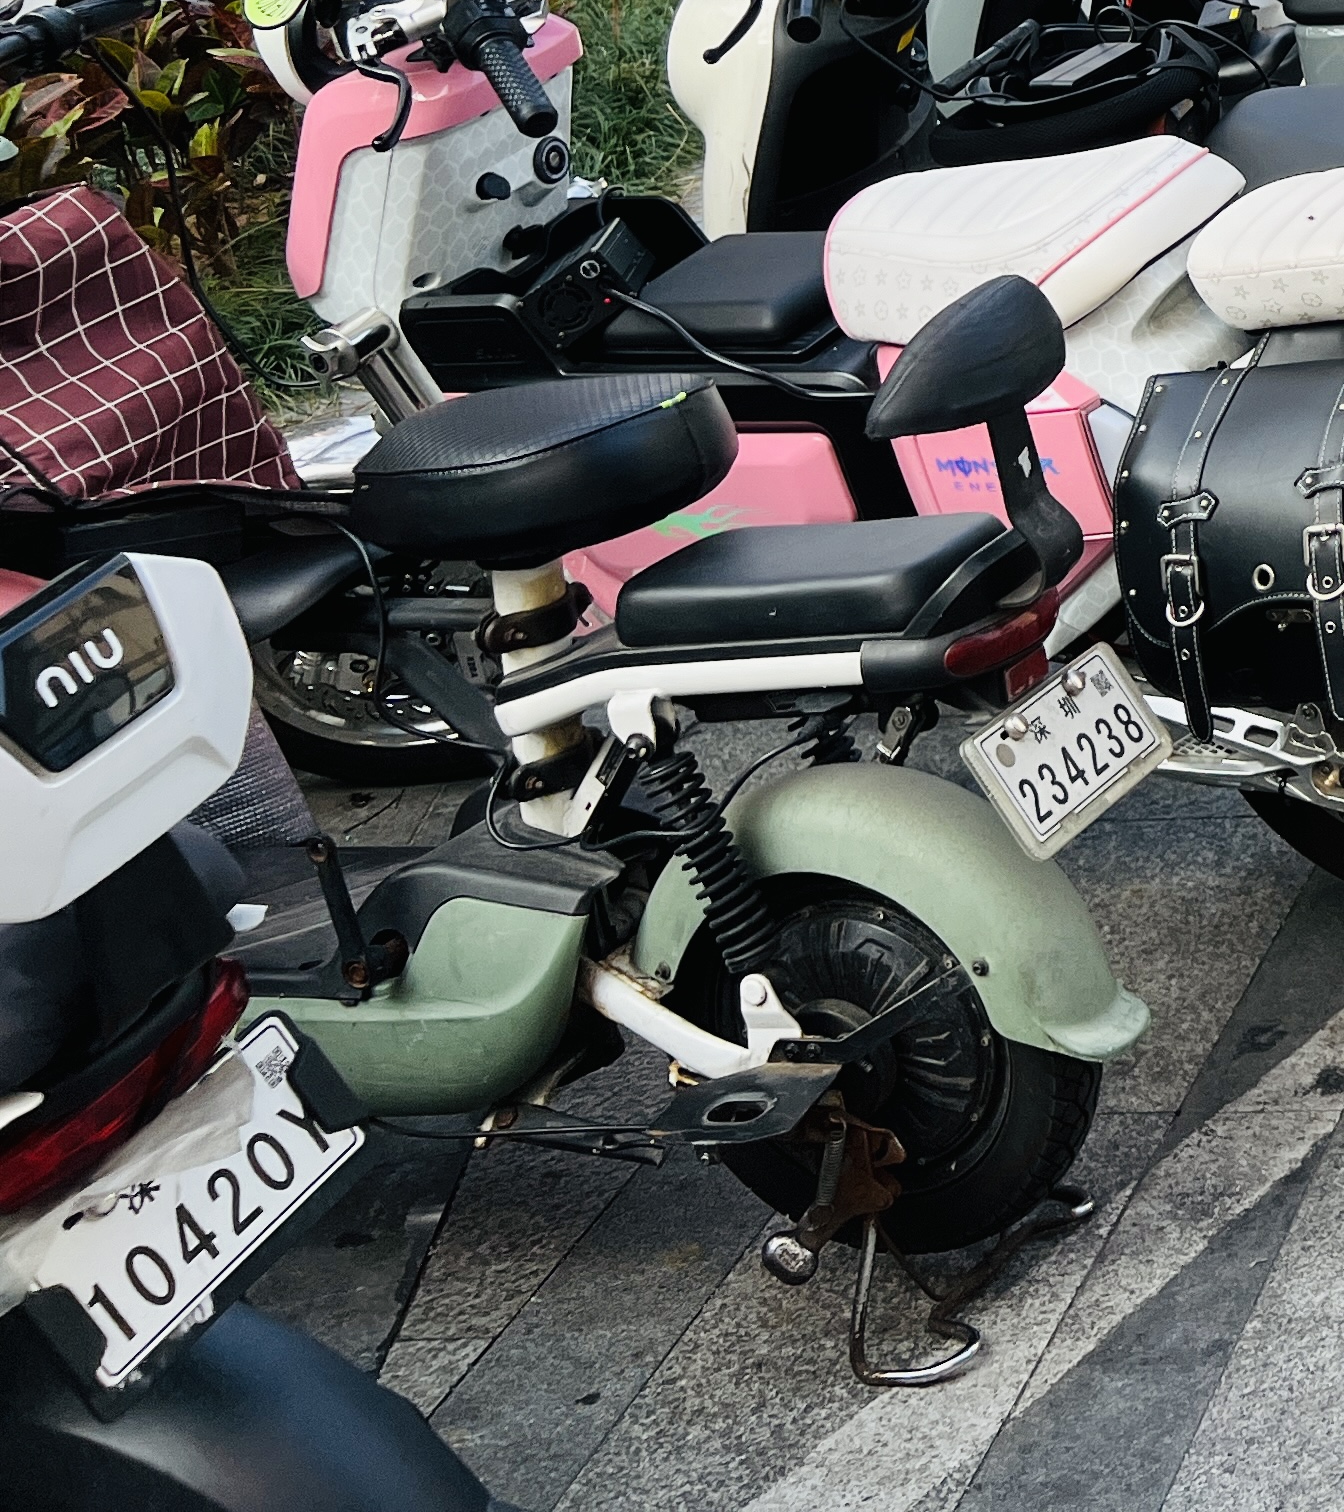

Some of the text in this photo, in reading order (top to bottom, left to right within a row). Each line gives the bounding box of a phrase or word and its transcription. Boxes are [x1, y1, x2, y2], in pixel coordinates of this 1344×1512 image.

[1018, 703, 1144, 824] 234238
[1028, 695, 1081, 744] 深圳
[87, 1108, 330, 1341] 10420Y
